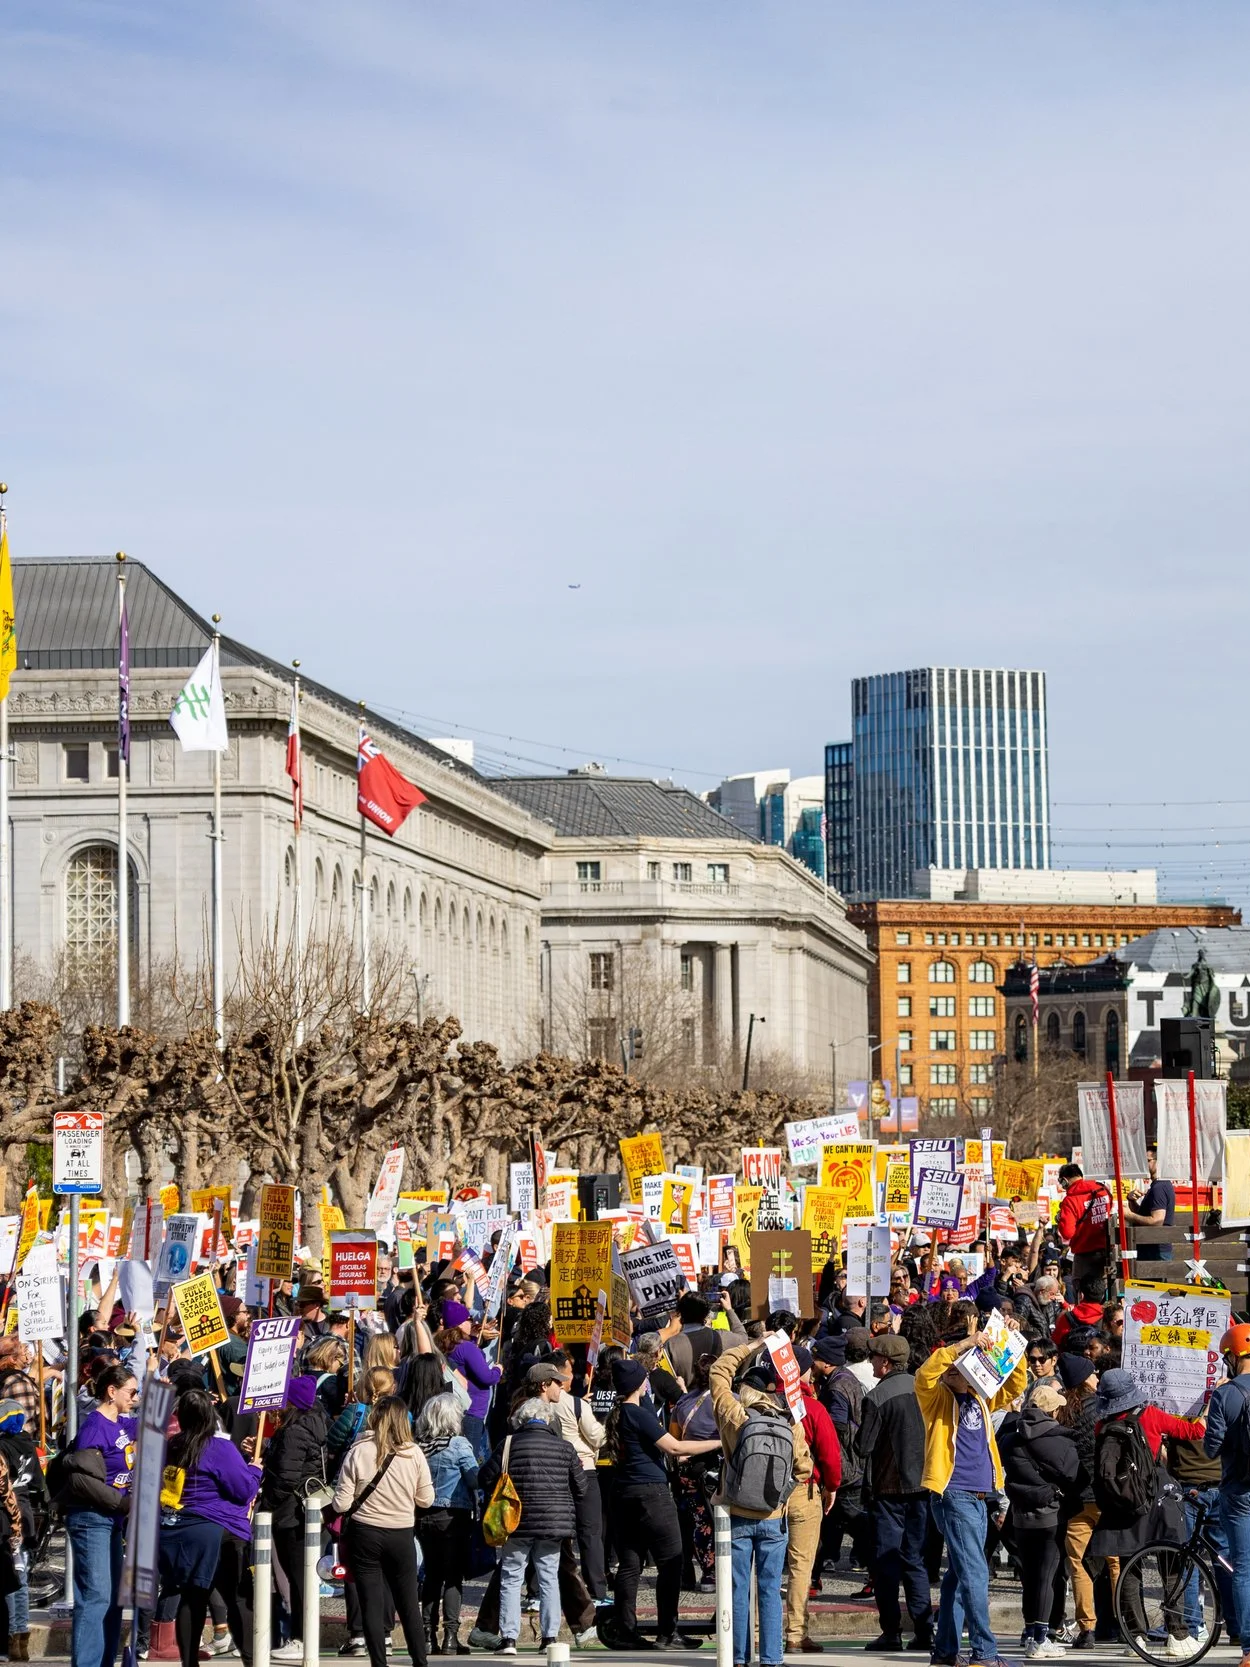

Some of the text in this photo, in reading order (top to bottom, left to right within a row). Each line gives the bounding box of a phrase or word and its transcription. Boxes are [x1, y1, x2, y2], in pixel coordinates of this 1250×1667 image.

[367, 800, 393, 824] UNION
[792, 1125, 857, 1148] We Your LIES
[823, 1145, 873, 1154] WE CAN'T WAIT
[913, 1140, 950, 1152] SEIU
[628, 1161, 661, 1172] SCHOOLS
[743, 1153, 782, 1188] ICE OUT
[922, 1170, 960, 1184] SEIU
[455, 1180, 481, 1191] NO CUTS
[267, 1195, 287, 1203] FULLY
[545, 1191, 565, 1200] CAN'T
[263, 1203, 292, 1213] STAFFED,
[548, 1199, 565, 1208] WAIT
[847, 1205, 867, 1213] SCHOOLS
[264, 1213, 288, 1221] STABLE
[487, 1208, 503, 1219] PUT
[855, 1210, 874, 1218] DESERVE
[927, 1208, 951, 1216] CONTRACT
[168, 1223, 195, 1233] SYMPATHY
[262, 1222, 292, 1231] SCHOOLS
[171, 1232, 187, 1241] STRIKE
[555, 1230, 609, 1244] 學生需要師
[335, 1252, 371, 1261] HUELGA
[624, 1249, 674, 1271] MAKE THE
[559, 1267, 604, 1282] 定的學校
[629, 1261, 677, 1280] BILLIONAIRES
[18, 1276, 58, 1288] ON STRIKE
[184, 1287, 207, 1299] FULLY
[180, 1291, 214, 1308] STAFFED,
[20, 1300, 46, 1311] SAFE
[184, 1299, 212, 1313] STABLE
[183, 1302, 217, 1321] SCHOOLS
[1158, 1301, 1220, 1328] 舊金山學區
[24, 1317, 54, 1327] STABLE
[25, 1324, 61, 1335] SCHOOLS
[255, 1319, 295, 1339] SEIU
[1149, 1328, 1199, 1345] 成績單
[780, 1347, 789, 1359] ON
[1207, 1351, 1219, 1362] D
[252, 1363, 262, 1373] NOT
[782, 1359, 797, 1375] STRIKE
[1130, 1357, 1216, 1375] 員工保險 D
[1206, 1377, 1215, 1389] F
[271, 1397, 283, 1405] 1021
[596, 1390, 616, 1401] UESF
